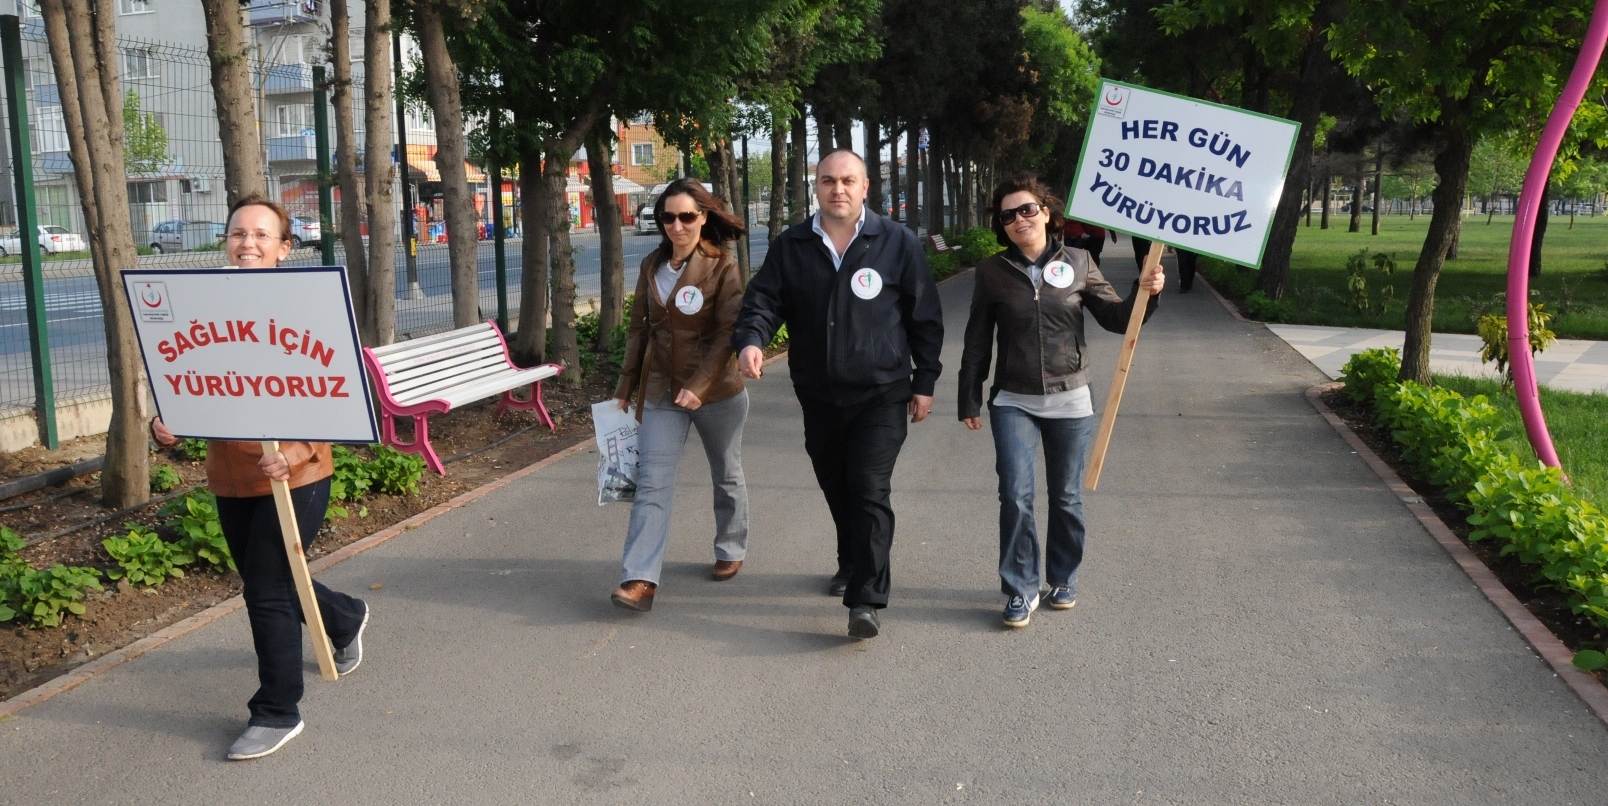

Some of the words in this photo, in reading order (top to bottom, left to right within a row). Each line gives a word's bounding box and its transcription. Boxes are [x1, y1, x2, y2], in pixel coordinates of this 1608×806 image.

[1121, 119, 1179, 142] HER
[1188, 127, 1251, 169] GÜN
[1098, 147, 1131, 172] 30
[1137, 157, 1244, 202] DAKİKA
[1089, 172, 1252, 236] YÜRÜYORUZ
[157, 319, 259, 363] SAĞLIK
[269, 318, 335, 368] İÇİN
[164, 371, 350, 398] YÜRÜYORUZ
